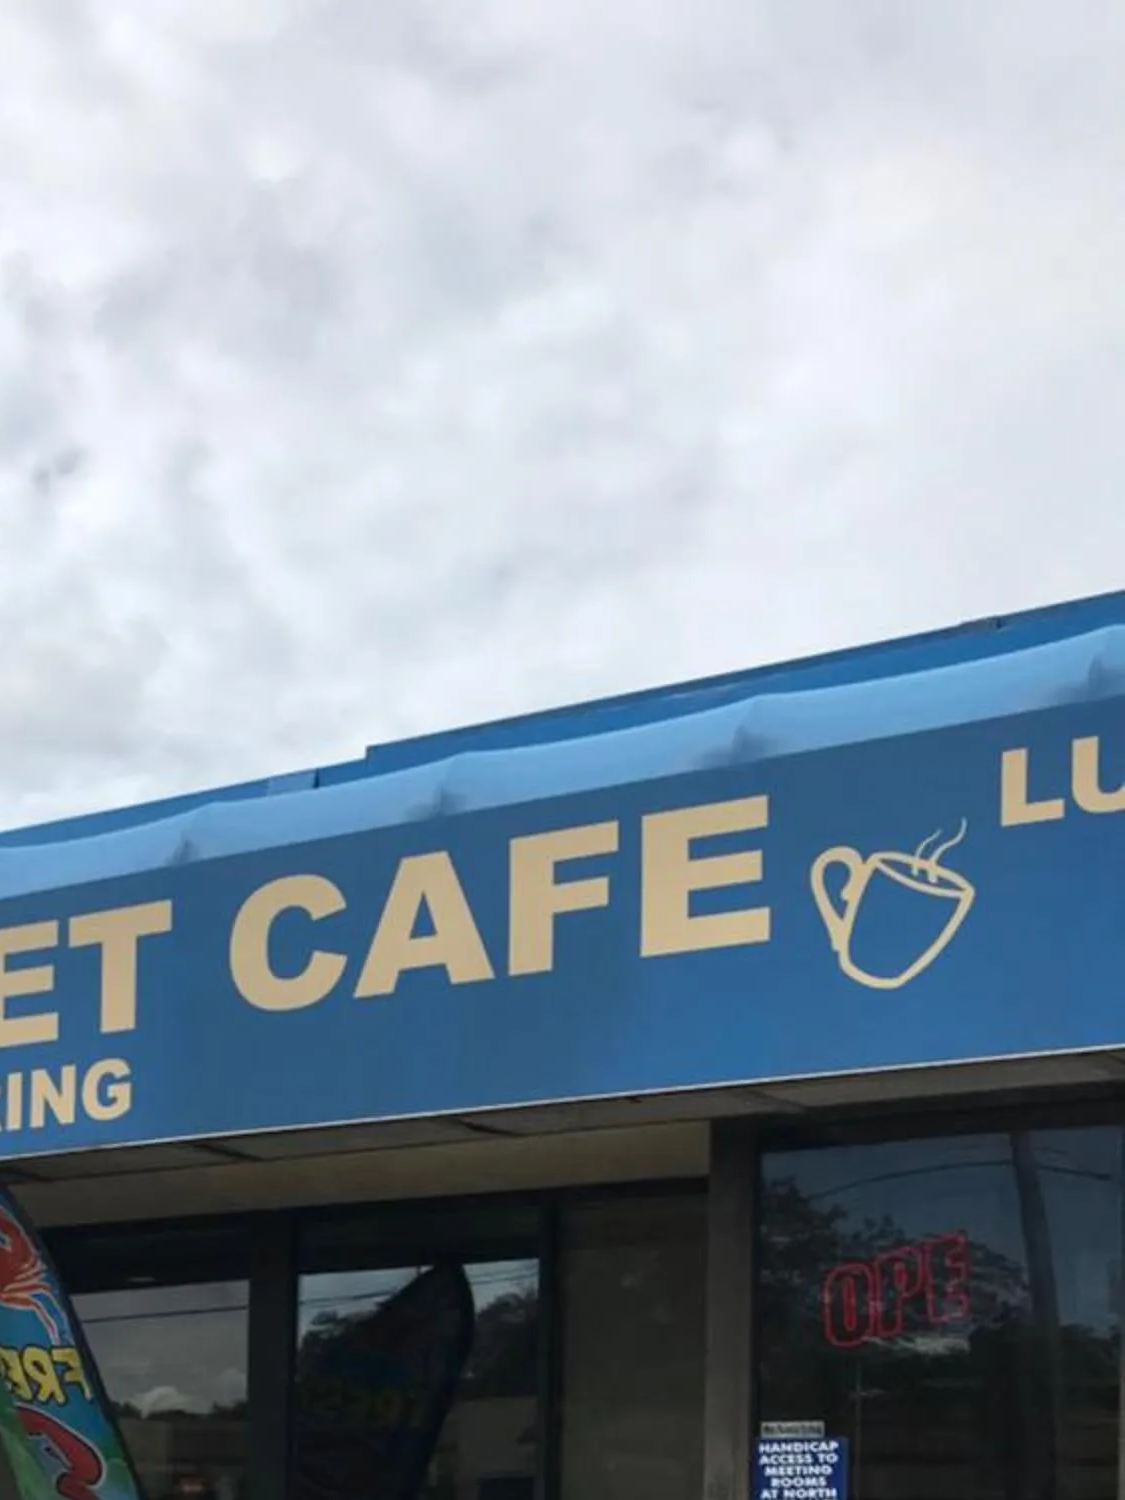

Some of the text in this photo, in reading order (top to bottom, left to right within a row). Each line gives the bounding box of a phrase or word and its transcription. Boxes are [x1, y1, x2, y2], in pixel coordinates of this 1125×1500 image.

[228, 794, 772, 1012] CAFE
[758, 1440, 840, 1453] HANDICAP
[759, 1452, 839, 1466] ACCESS TO
[764, 1464, 833, 1477] MEETING
[770, 1476, 828, 1488] ROOMS
[760, 1486, 838, 1499] AT NORTH
